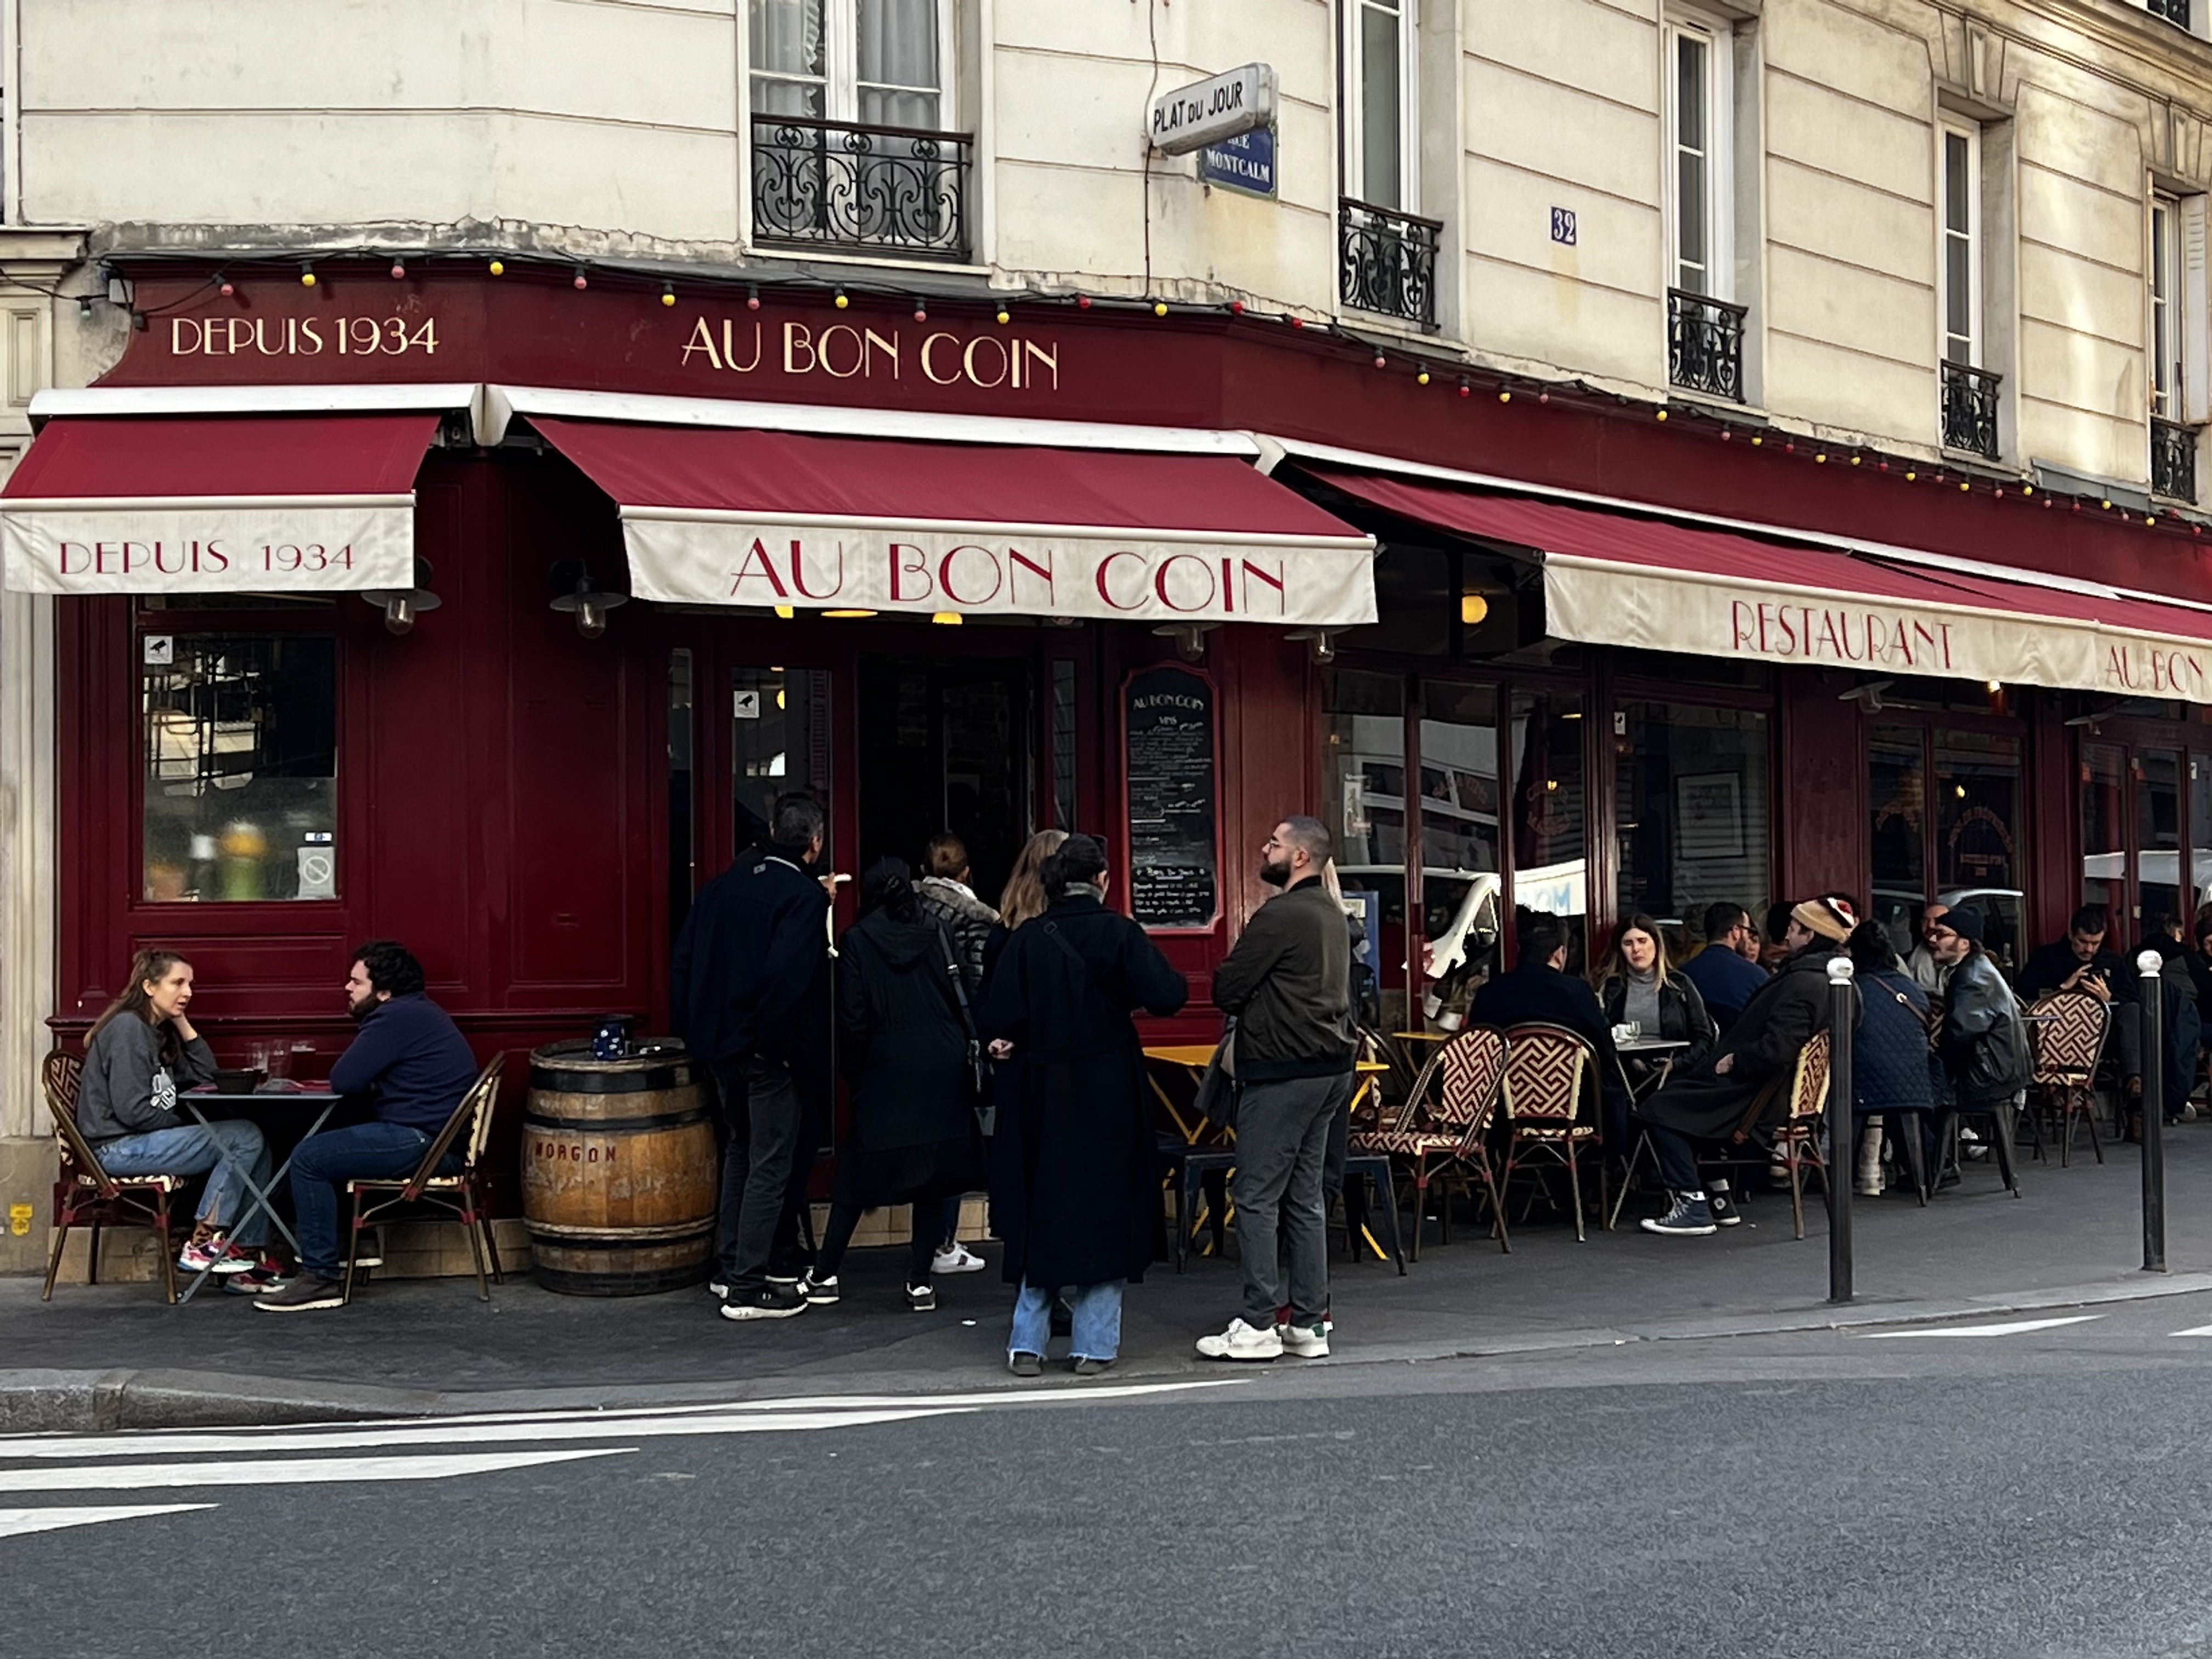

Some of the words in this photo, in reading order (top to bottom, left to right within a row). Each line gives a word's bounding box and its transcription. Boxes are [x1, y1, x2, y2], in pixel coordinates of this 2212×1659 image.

[1154, 100, 1186, 135] PLAT
[1188, 100, 1204, 124] DU
[1208, 81, 1243, 116] JOUR
[1206, 148, 1270, 183] MONTCALM
[1553, 209, 1575, 243] 32
[172, 317, 323, 356] DEPUIS
[335, 316, 440, 356] 1934
[682, 317, 762, 372] AU
[785, 322, 899, 380] BON
[921, 332, 1058, 390] COIN
[59, 539, 229, 575] DEPUIS
[261, 543, 355, 573] 1934
[731, 537, 843, 599] AU
[889, 543, 1056, 607] BON
[1096, 551, 1285, 615] COIN
[1732, 600, 1951, 669] RESTAURANT
[2106, 645, 2141, 689] AU
[2152, 650, 2204, 697] BON
[535, 1141, 616, 1163] MORGON
